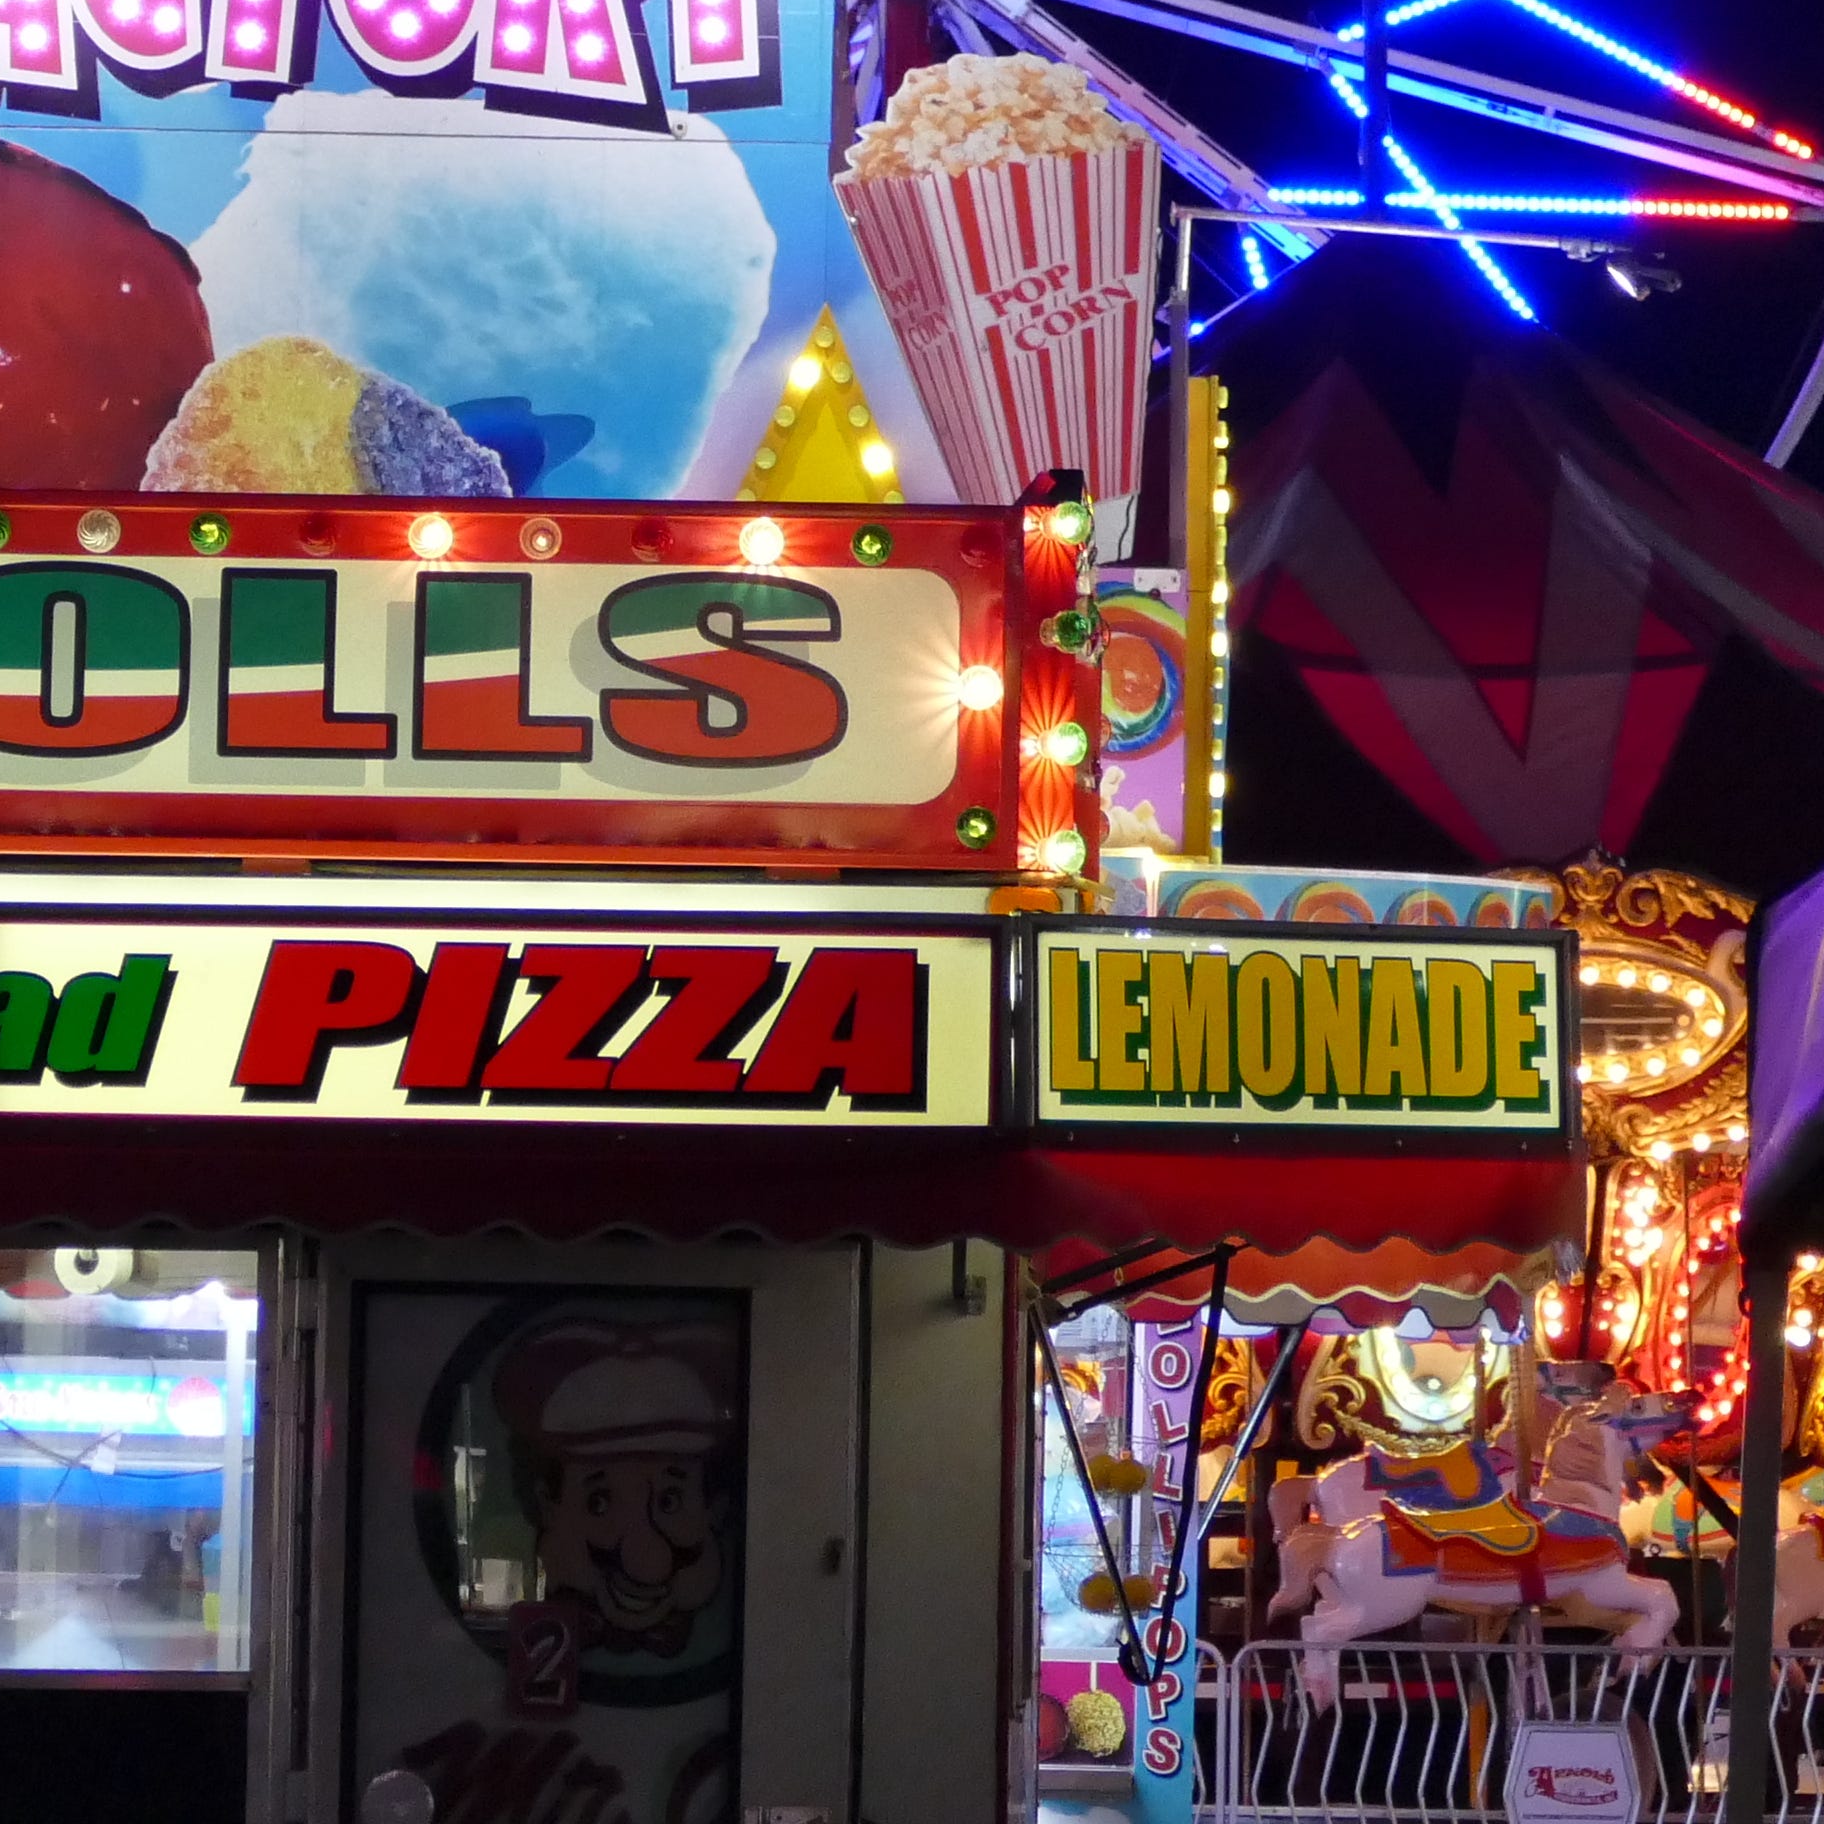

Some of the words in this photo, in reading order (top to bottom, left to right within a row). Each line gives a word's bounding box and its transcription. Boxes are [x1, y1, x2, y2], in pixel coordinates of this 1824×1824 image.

[985, 263, 1072, 318] POP
[1013, 277, 1136, 352] CORN
[231, 938, 928, 1114] PIZZA
[1047, 945, 1554, 1114] LEMONADE
[1142, 1319, 1192, 1775] OLLIPOPS
[520, 1617, 570, 1705] 2
